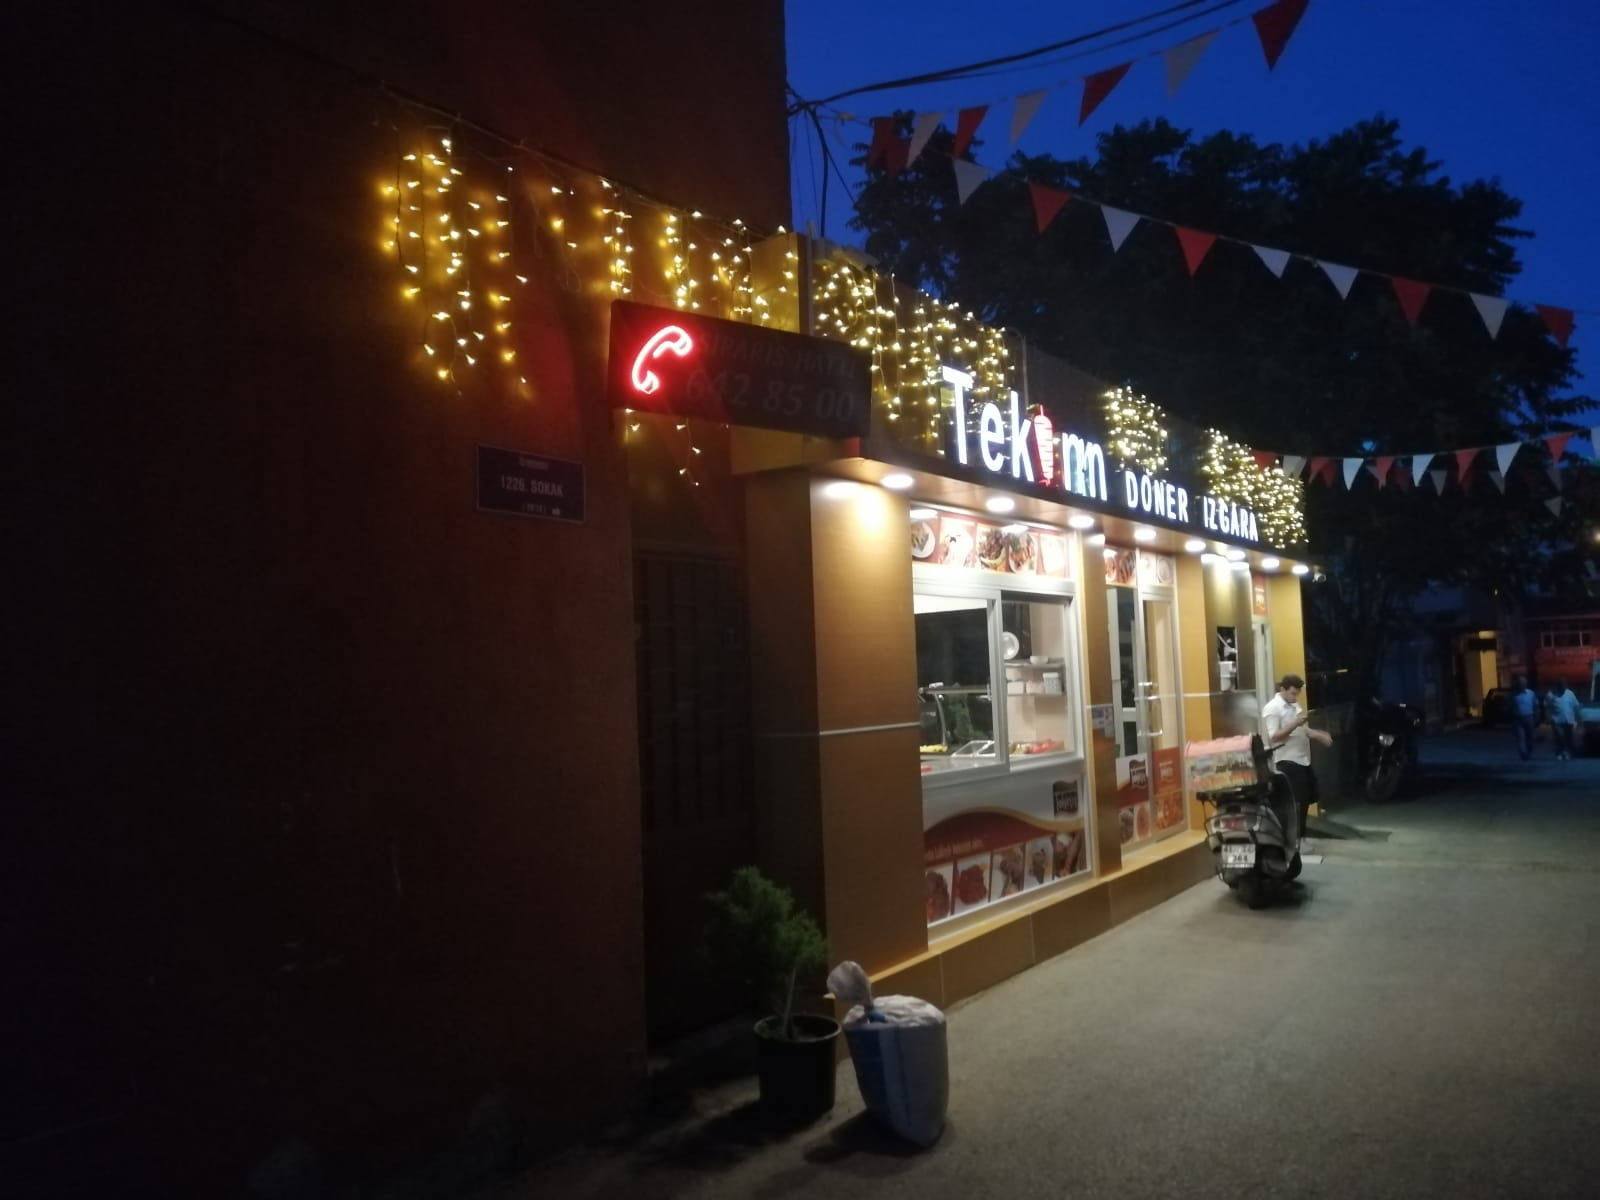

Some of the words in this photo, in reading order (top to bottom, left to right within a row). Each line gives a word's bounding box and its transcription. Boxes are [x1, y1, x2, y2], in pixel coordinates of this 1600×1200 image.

[762, 380, 806, 416] 85
[816, 387, 855, 423] 00
[530, 480, 564, 497] SOKAK
